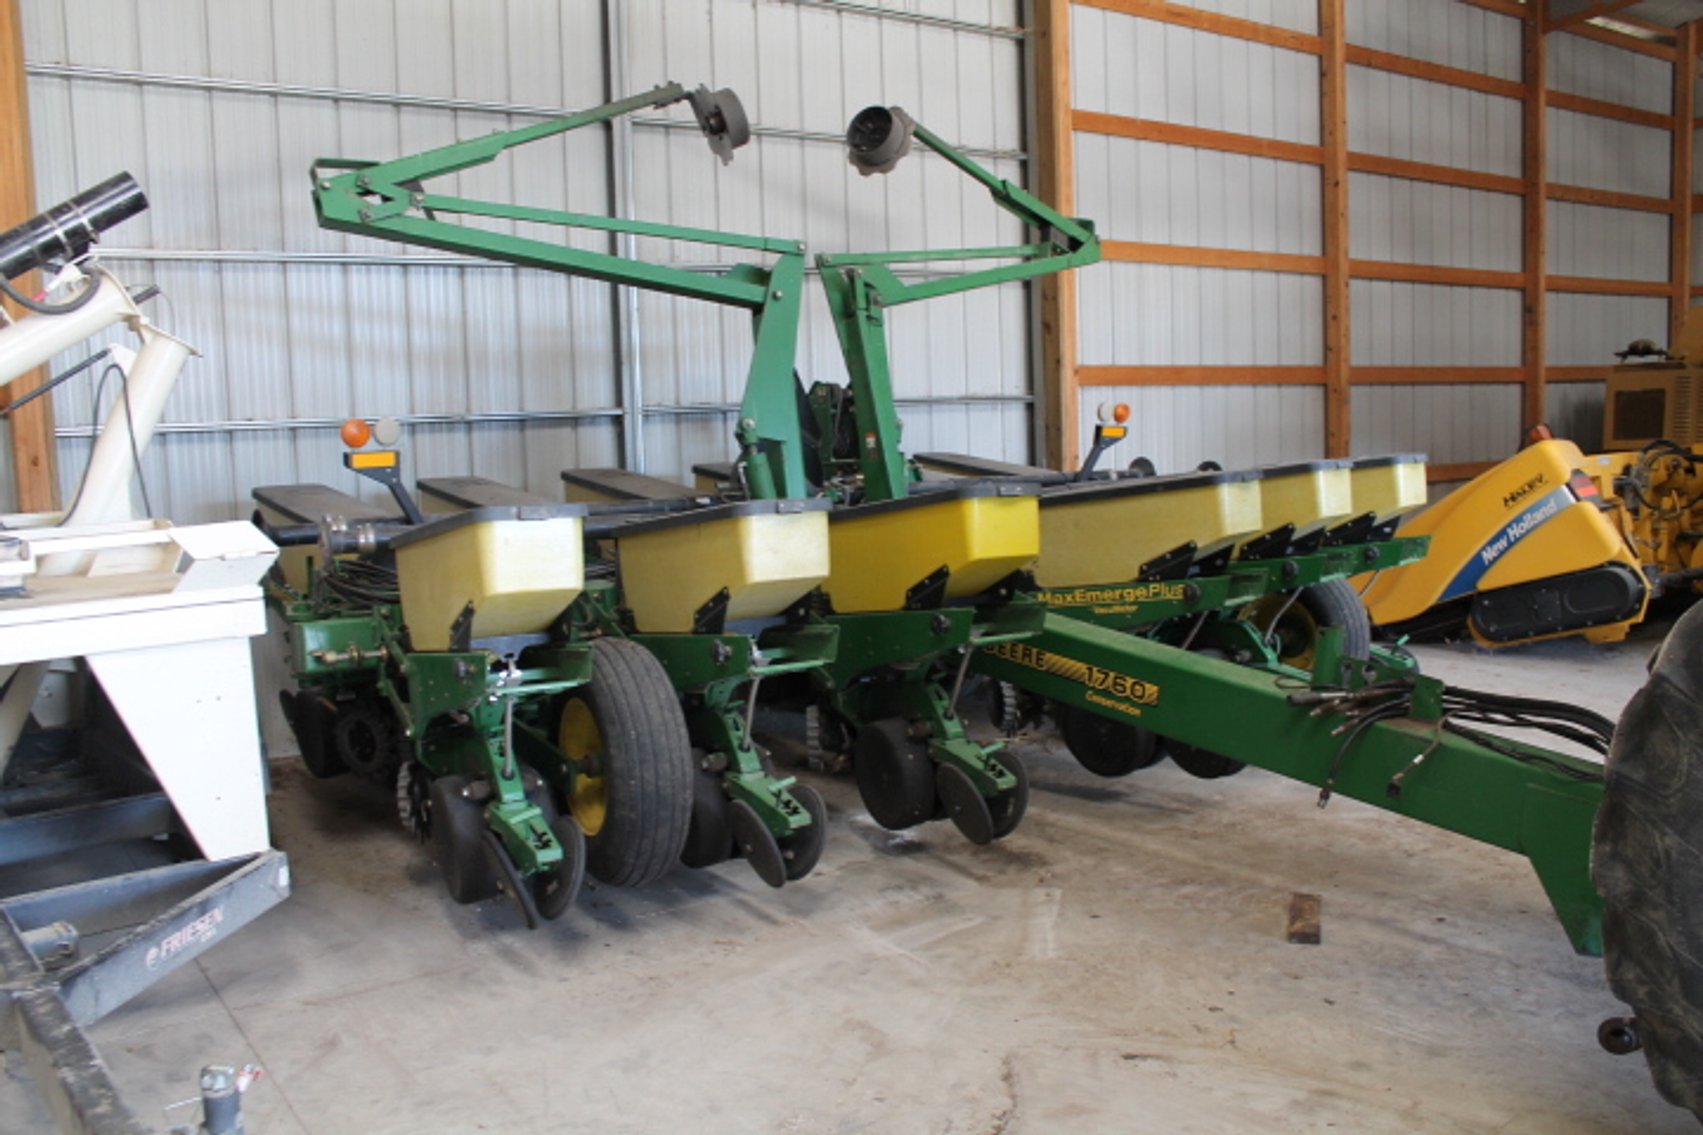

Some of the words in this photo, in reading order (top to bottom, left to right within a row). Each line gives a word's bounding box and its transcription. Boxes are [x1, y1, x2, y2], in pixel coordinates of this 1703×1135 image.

[1481, 535, 1508, 566] New
[1506, 498, 1557, 542] Holland
[1085, 690, 1142, 717] Conservation
[1086, 666, 1145, 700] 1760
[161, 905, 224, 960] FRIESEN
